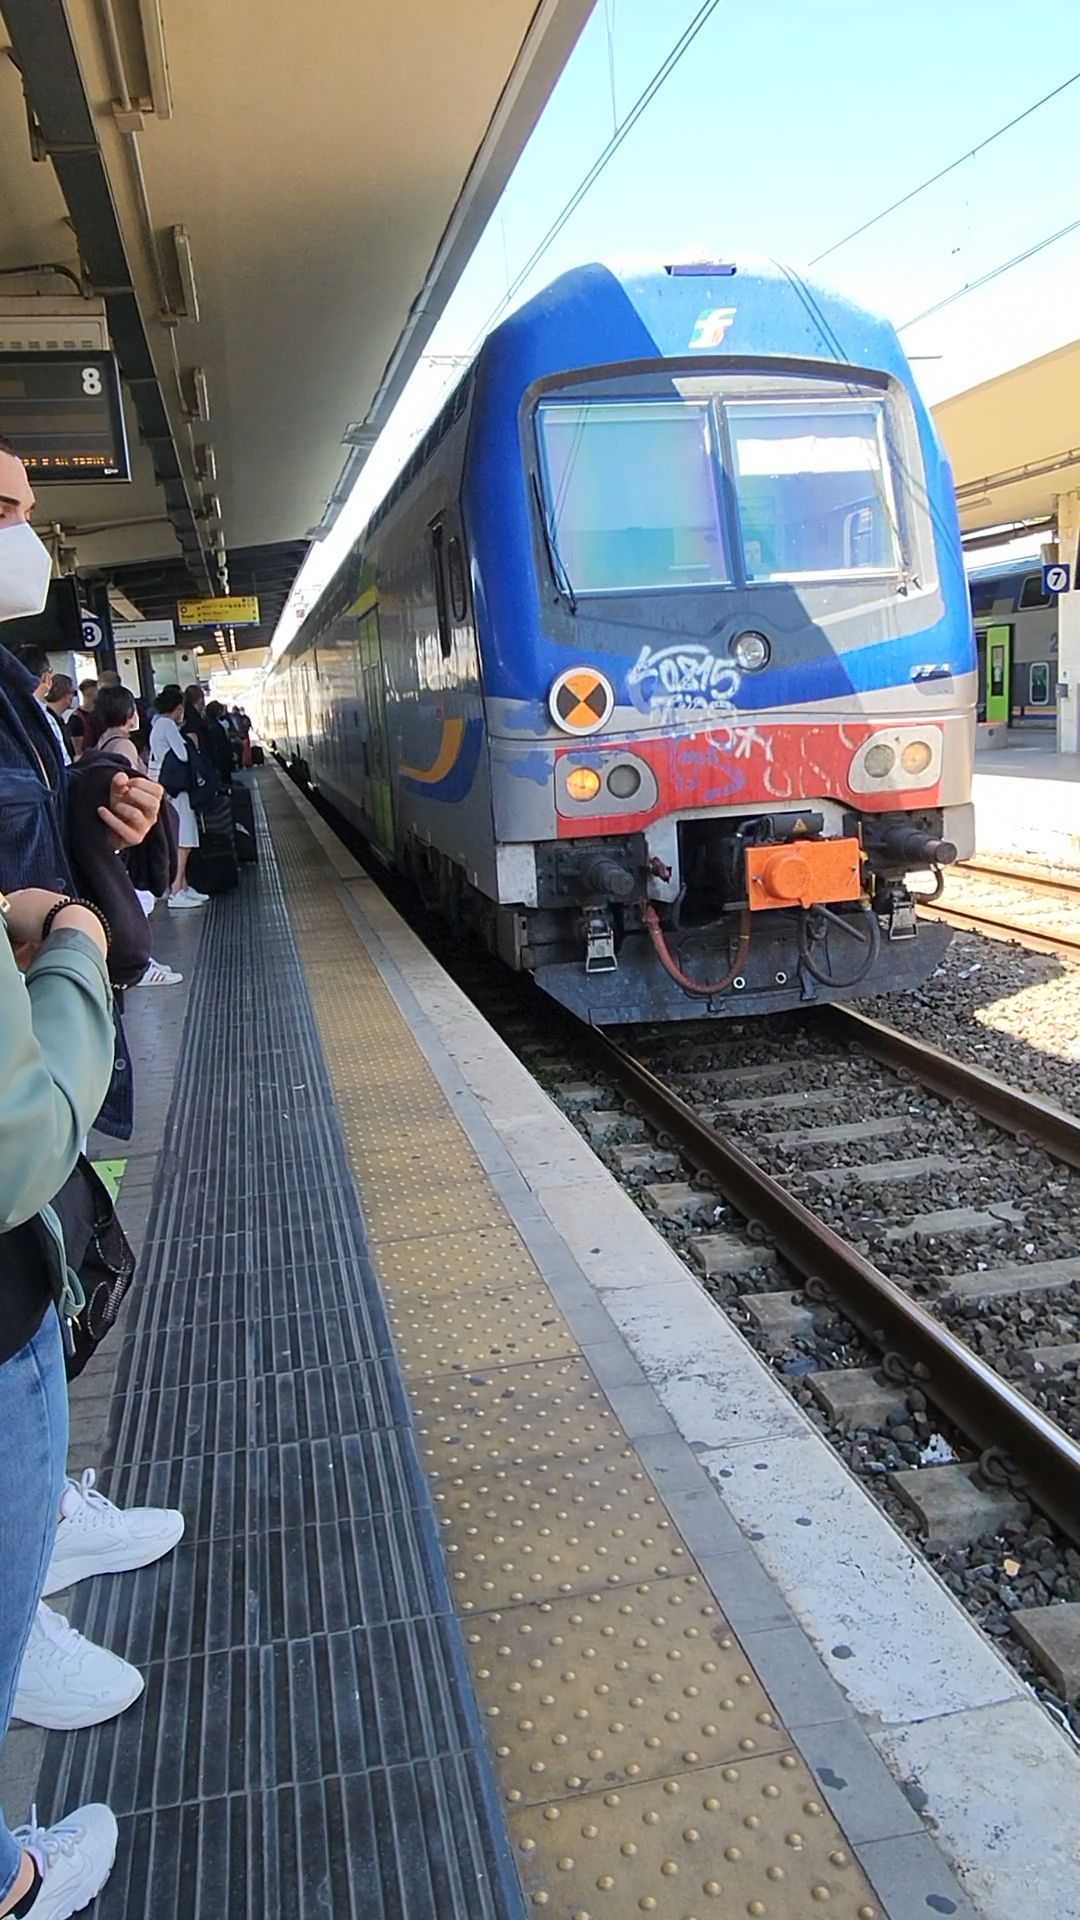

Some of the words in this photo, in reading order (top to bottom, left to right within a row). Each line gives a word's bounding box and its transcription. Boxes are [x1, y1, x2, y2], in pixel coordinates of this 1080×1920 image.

[81, 367, 102, 395] 8
[1052, 572, 1063, 587] 7
[84, 626, 96, 643] 8
